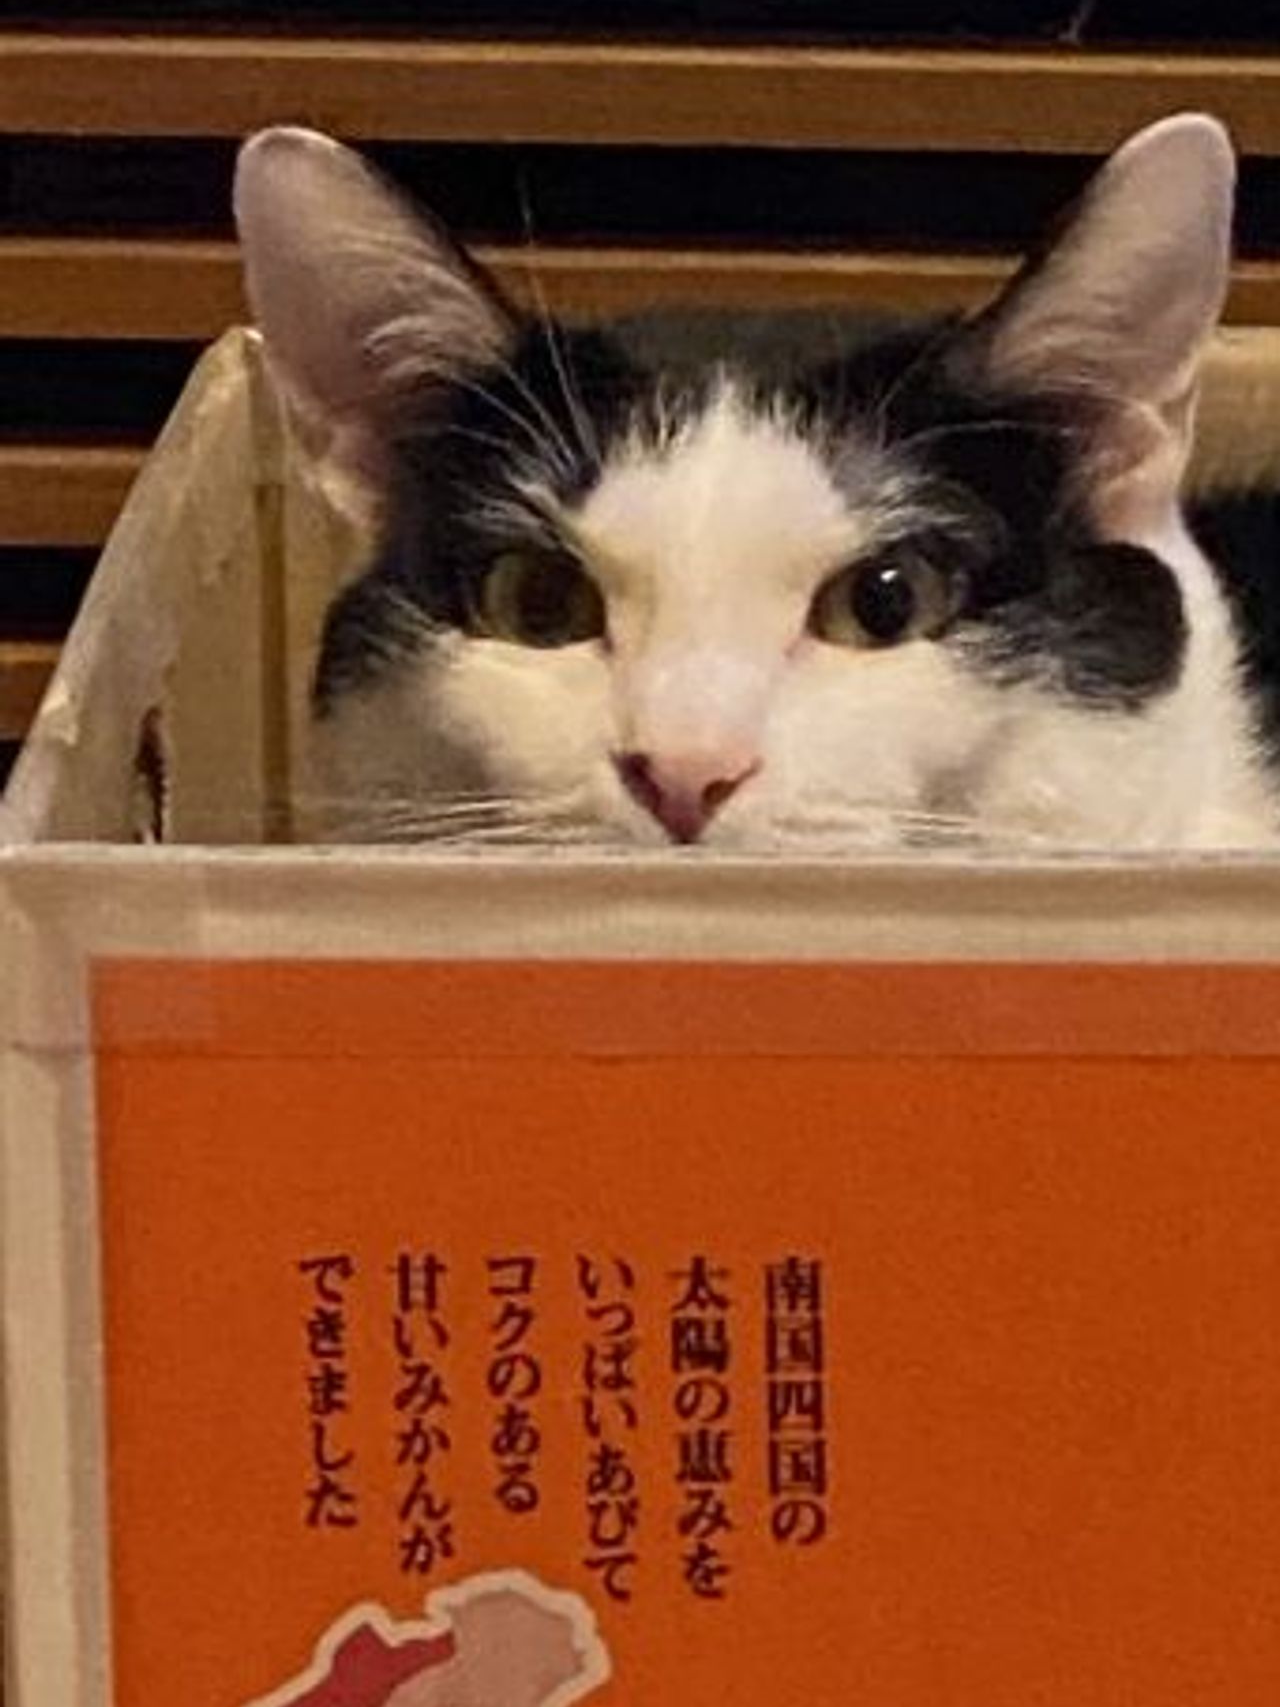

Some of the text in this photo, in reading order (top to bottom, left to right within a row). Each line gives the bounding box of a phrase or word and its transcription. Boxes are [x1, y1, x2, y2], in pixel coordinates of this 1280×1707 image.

[300, 1254, 358, 1527] できました
[387, 1252, 454, 1573] 甘いみかんが
[486, 1256, 542, 1513] コクのある
[666, 1256, 732, 1598] 太陽の恵みを
[765, 1256, 827, 1546] 南国四国の
